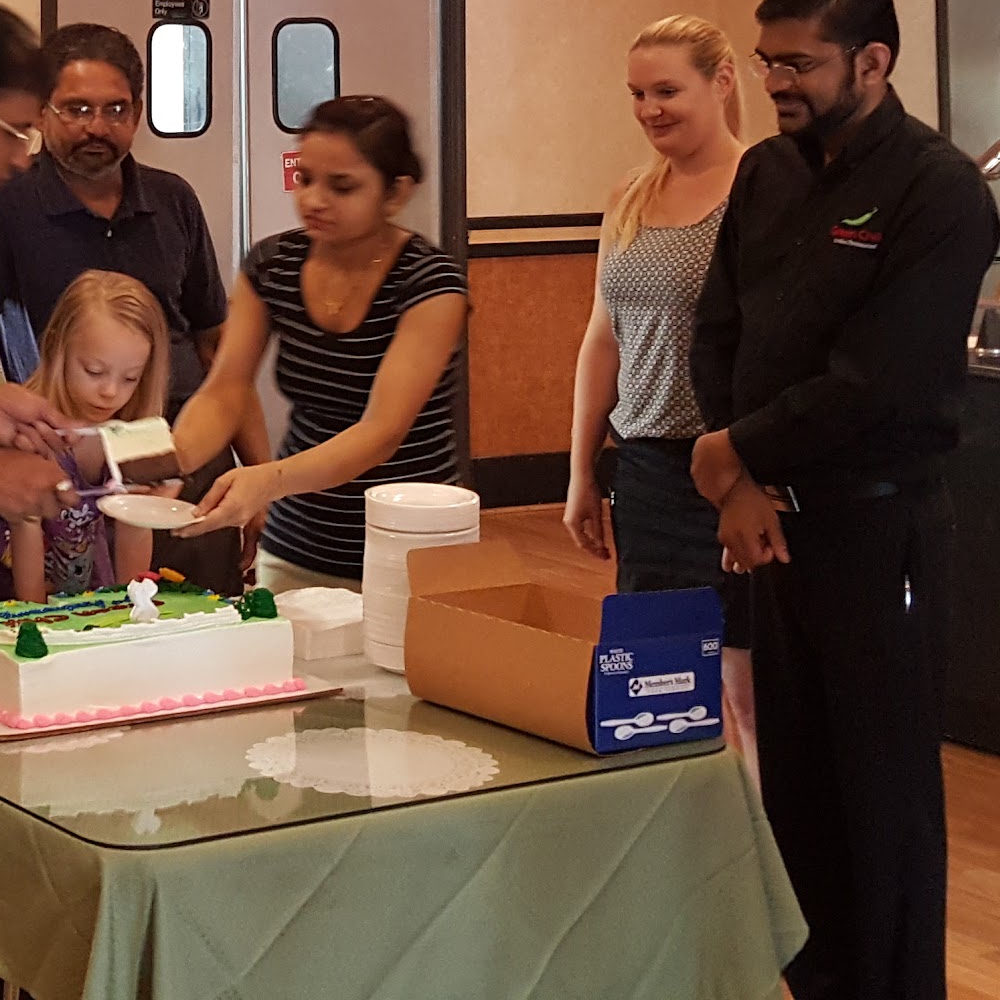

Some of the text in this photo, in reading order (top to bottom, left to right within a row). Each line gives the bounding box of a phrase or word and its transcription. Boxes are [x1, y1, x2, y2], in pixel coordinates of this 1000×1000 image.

[154, 0, 185, 8] Employees
[599, 652, 634, 663] PLASTIC
[600, 661, 633, 671] SPOONS
